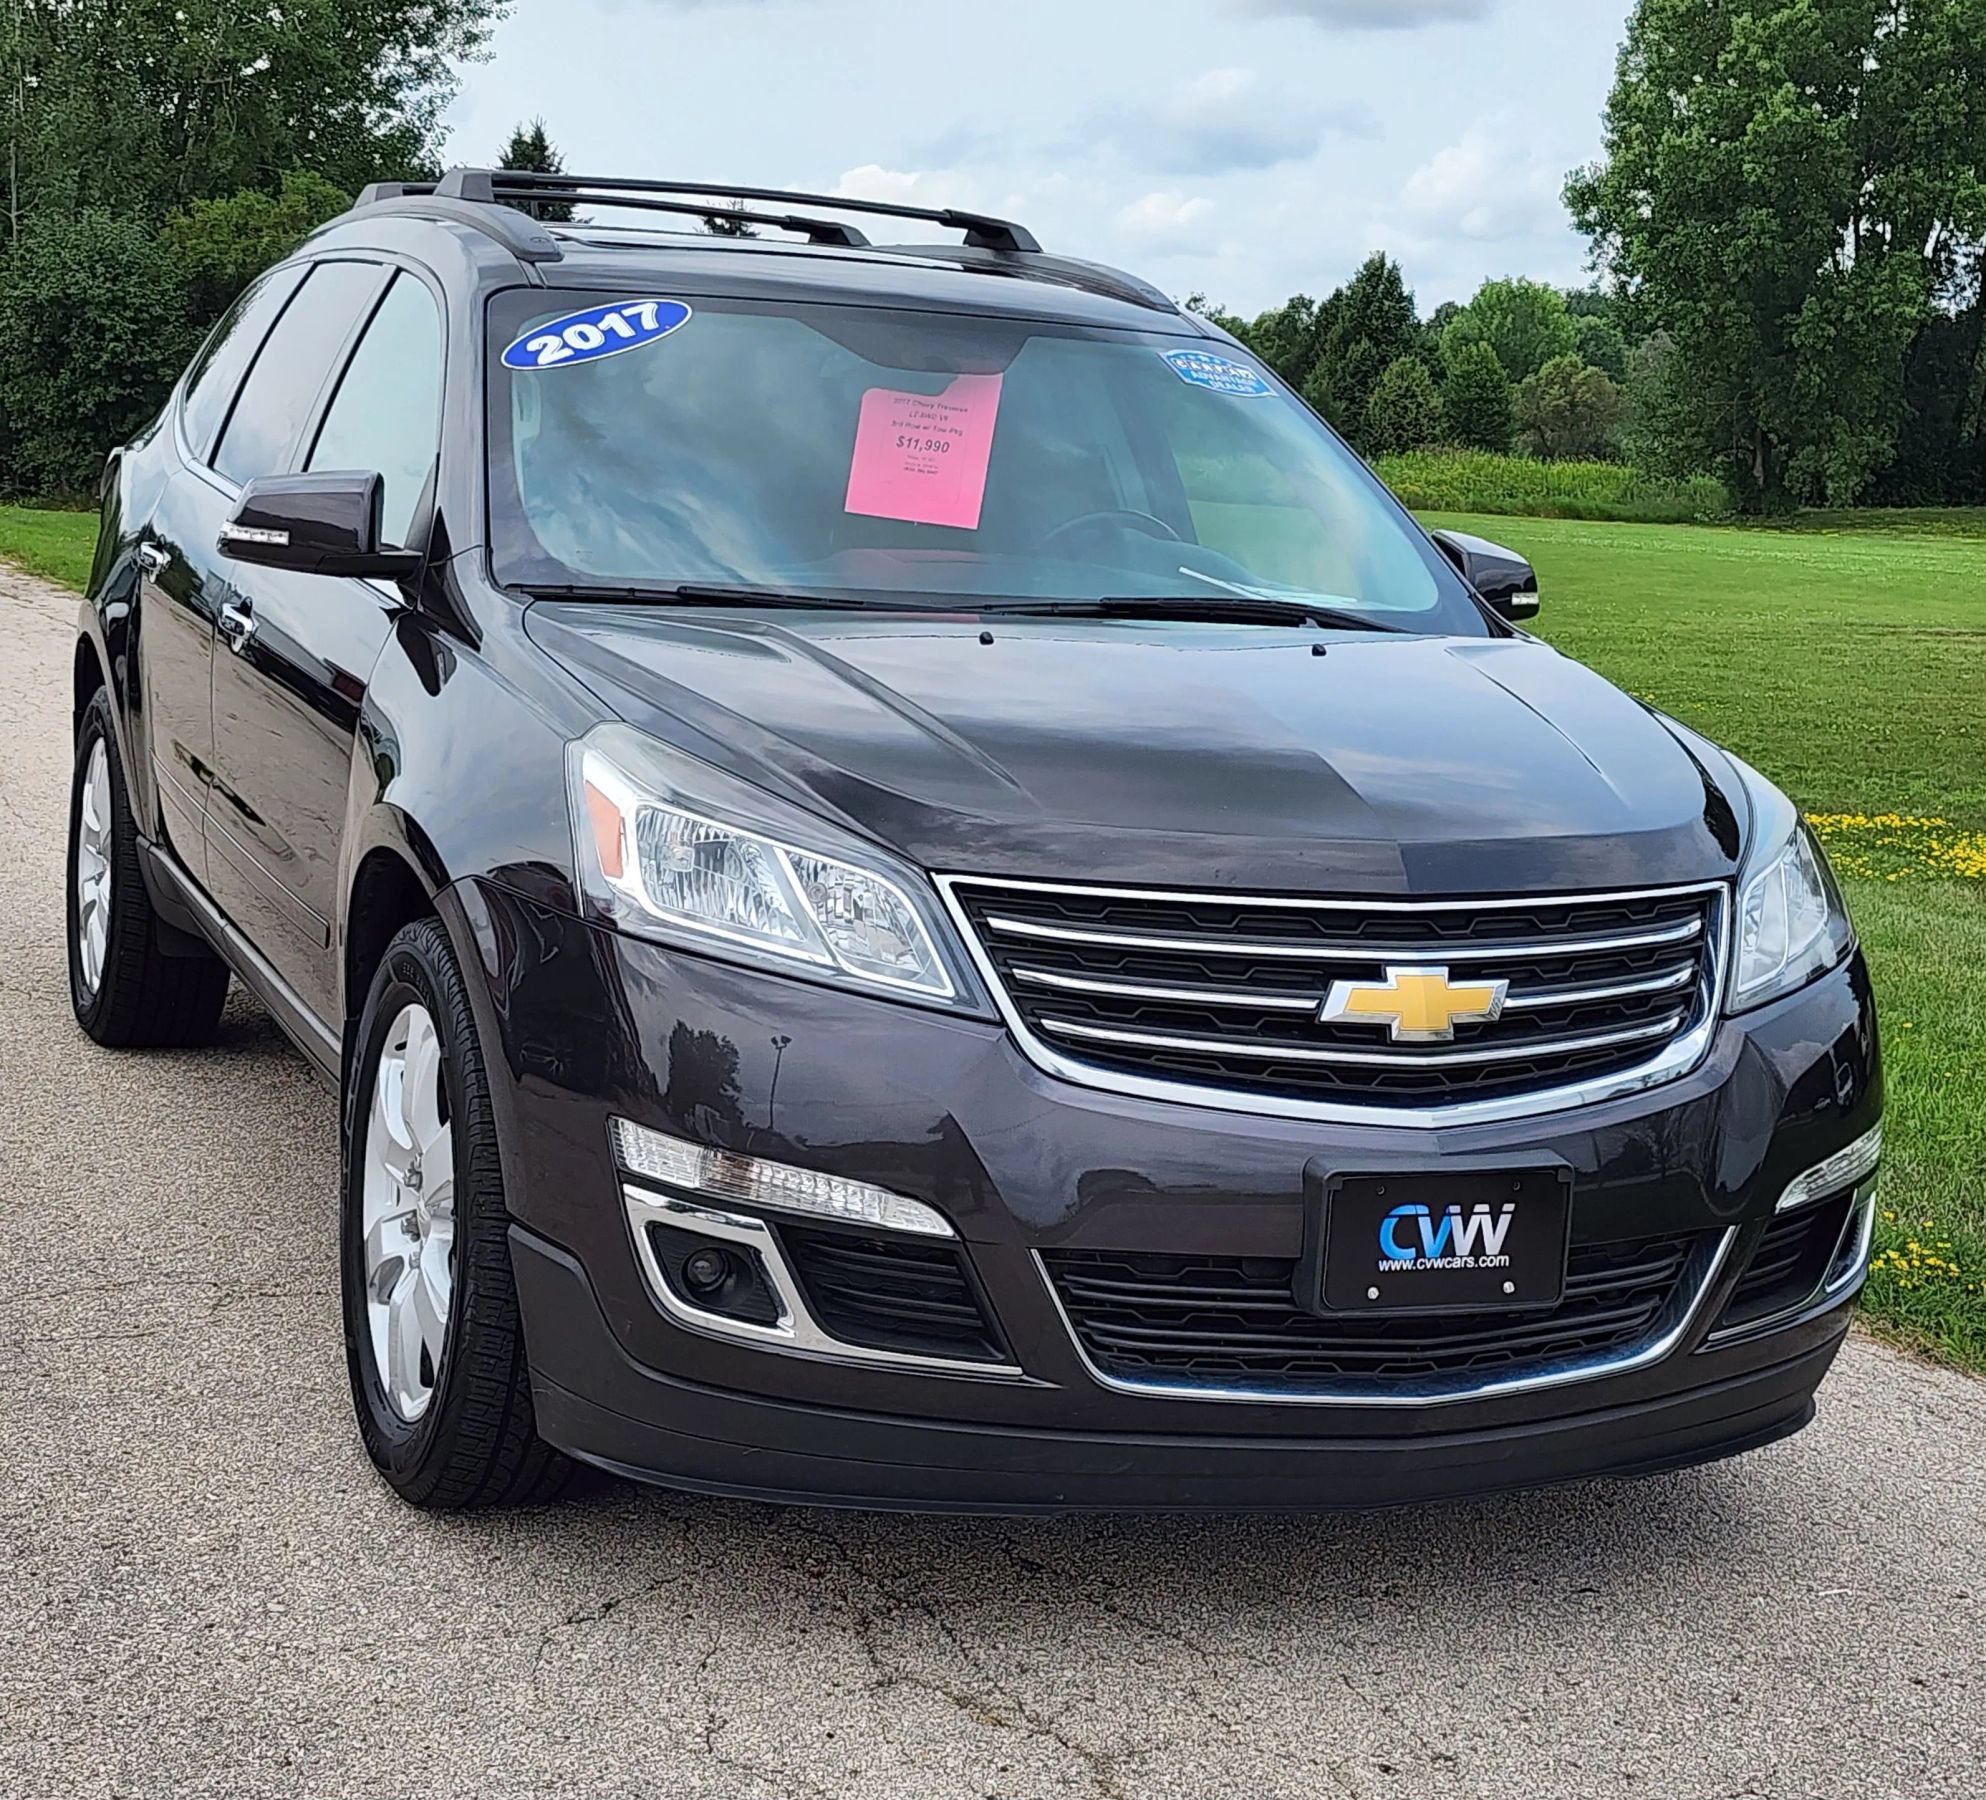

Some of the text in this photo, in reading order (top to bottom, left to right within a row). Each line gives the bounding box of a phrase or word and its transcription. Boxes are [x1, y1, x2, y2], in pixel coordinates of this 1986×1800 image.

[526, 303, 659, 365] 2017
[896, 435, 950, 453] $11,990
[1379, 1203, 1516, 1261] CVW
[1378, 1254, 1510, 1272] www.cvwcars.com
